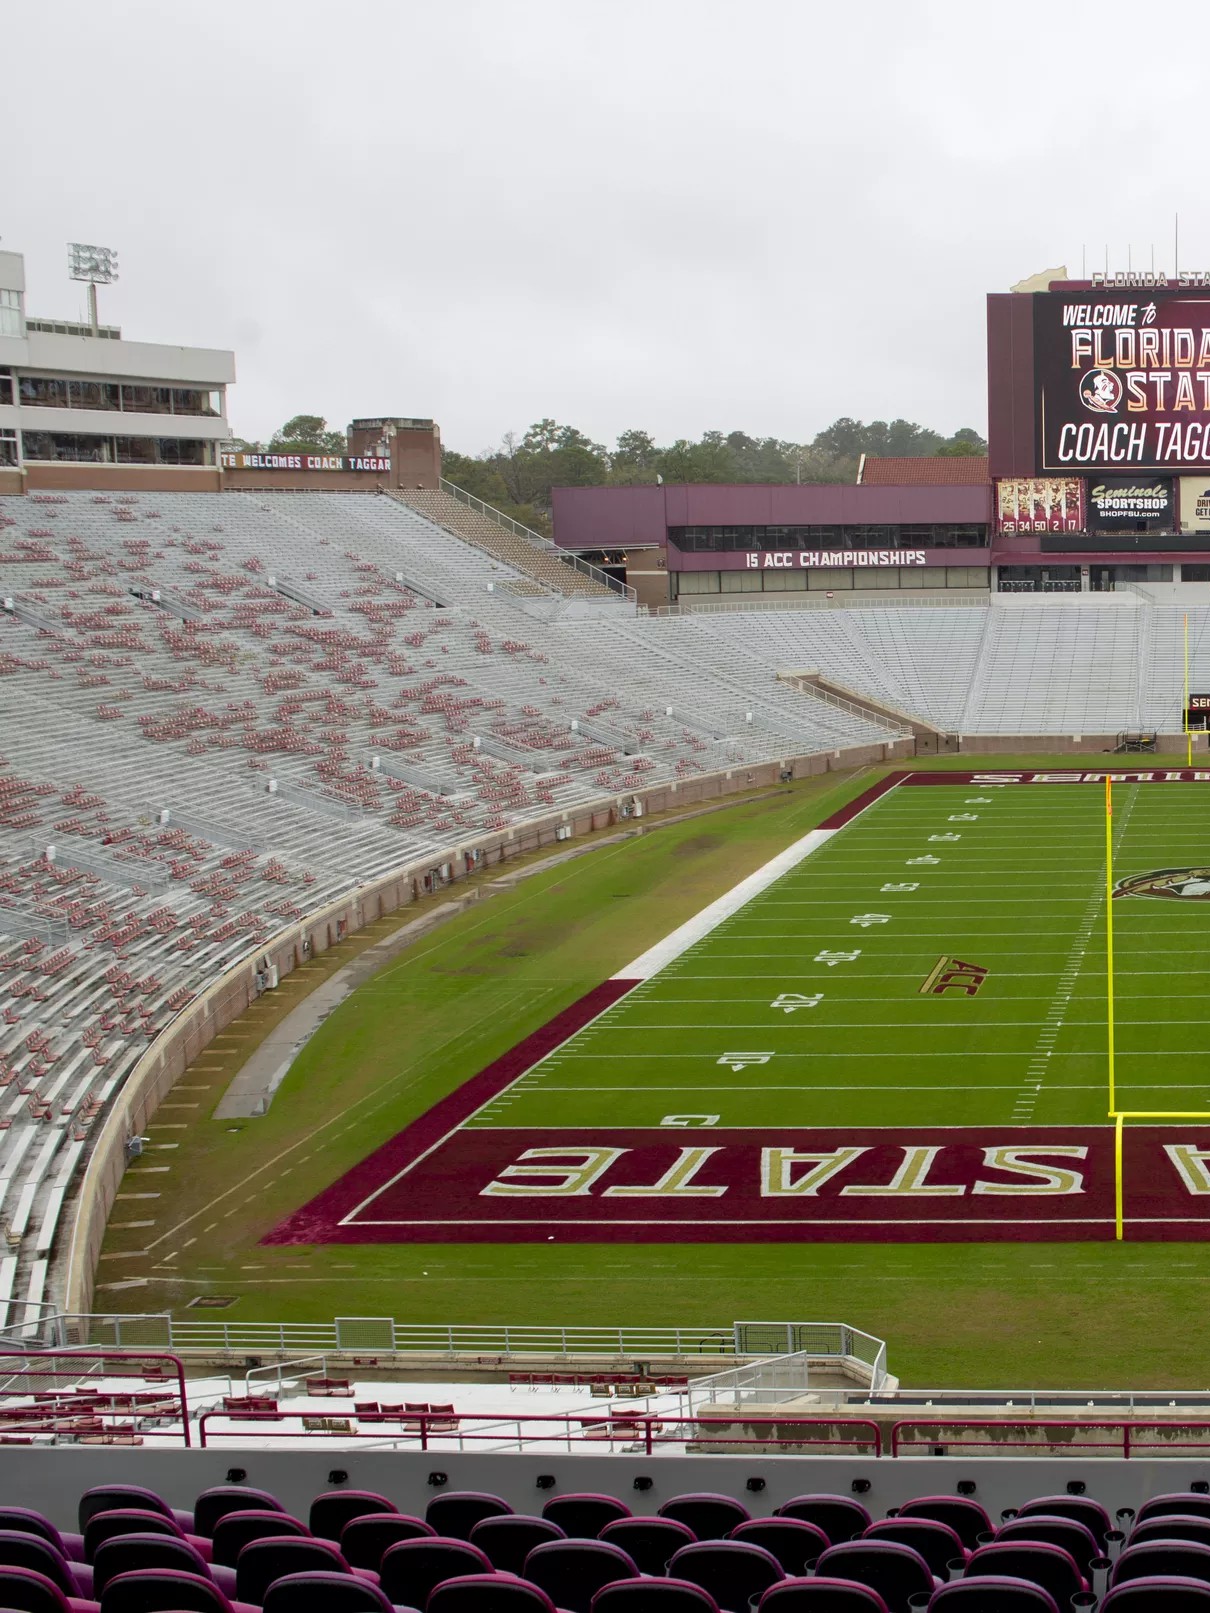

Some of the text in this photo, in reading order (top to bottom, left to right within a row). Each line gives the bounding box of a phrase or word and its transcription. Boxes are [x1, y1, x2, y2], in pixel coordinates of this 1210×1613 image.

[1091, 272, 1168, 288] FLORIDA
[1062, 302, 1156, 326] WELCOME to
[1058, 422, 1147, 461] COACH
[242, 454, 301, 468] WELCOMES
[307, 456, 343, 469] COACH
[1091, 484, 1168, 501] Seminole
[1097, 498, 1168, 509] SPORTSHOP
[1003, 520, 1076, 532] 25 34 50 2 17
[746, 550, 926, 567] 15 ACC CHAMPIONSHIPS
[930, 959, 990, 997] ACC
[770, 993, 824, 1007] 20
[716, 1051, 775, 1064] 10
[478, 1144, 1088, 1198] STATE
